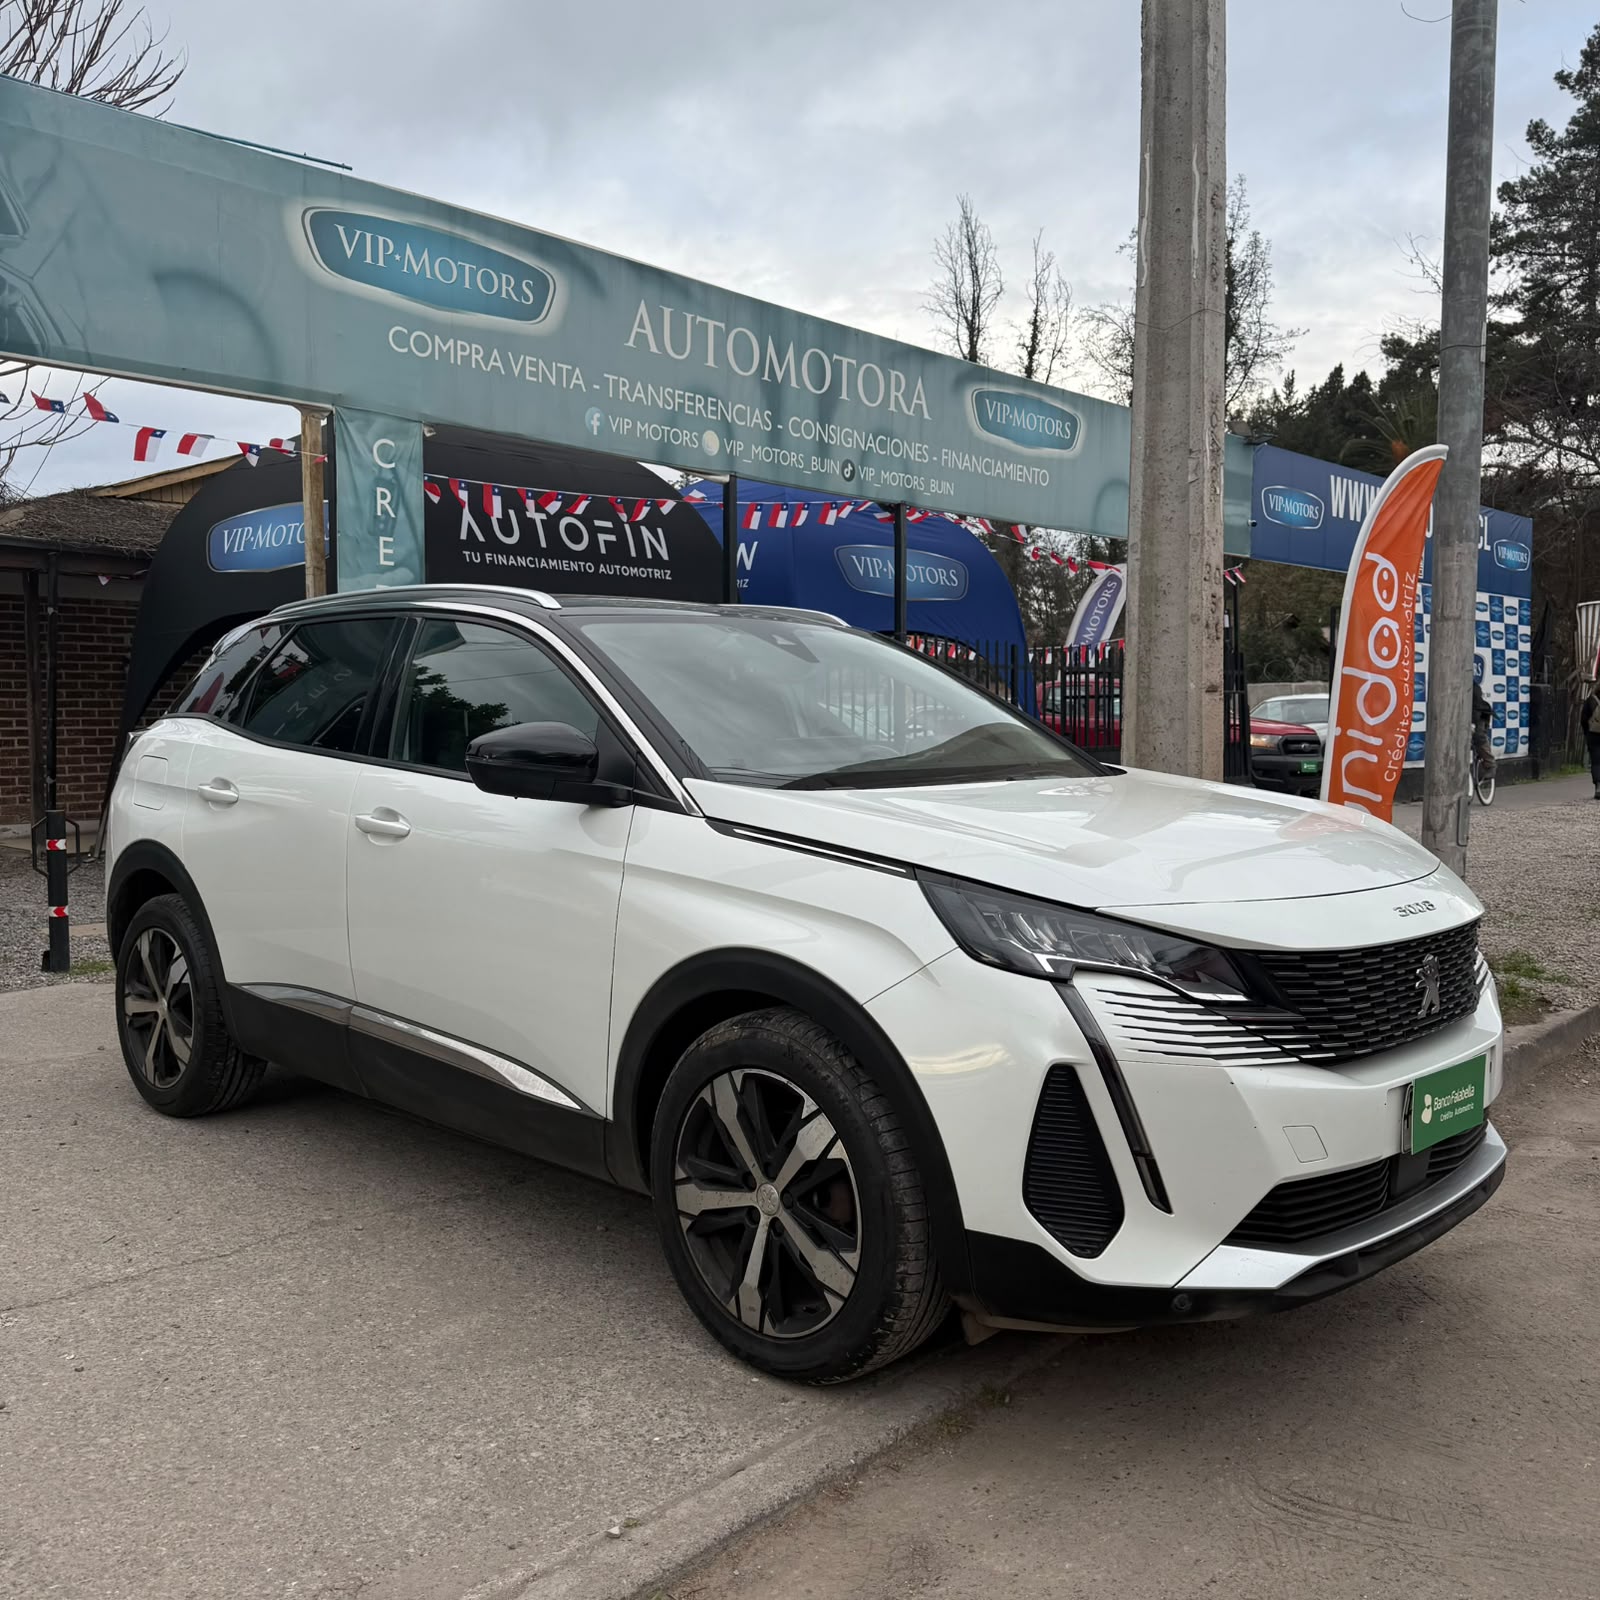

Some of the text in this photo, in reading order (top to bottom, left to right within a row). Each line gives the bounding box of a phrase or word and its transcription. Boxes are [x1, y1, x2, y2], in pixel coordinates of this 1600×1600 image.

[624, 299, 932, 420] AUTOMOTORA
[388, 326, 505, 375] COMPRA
[508, 352, 586, 392] VENTA
[603, 374, 772, 432] TRANSFERENCIAS
[788, 416, 929, 464] CONSIGNACIONES
[941, 449, 1049, 487] FINANCIAMIENTO
[609, 415, 699, 449] VIP MOTORS
[460, 505, 669, 561] AUTOFIN
[463, 550, 672, 580] TU FINANCIAMIENTO AUTOMOTRIZ
